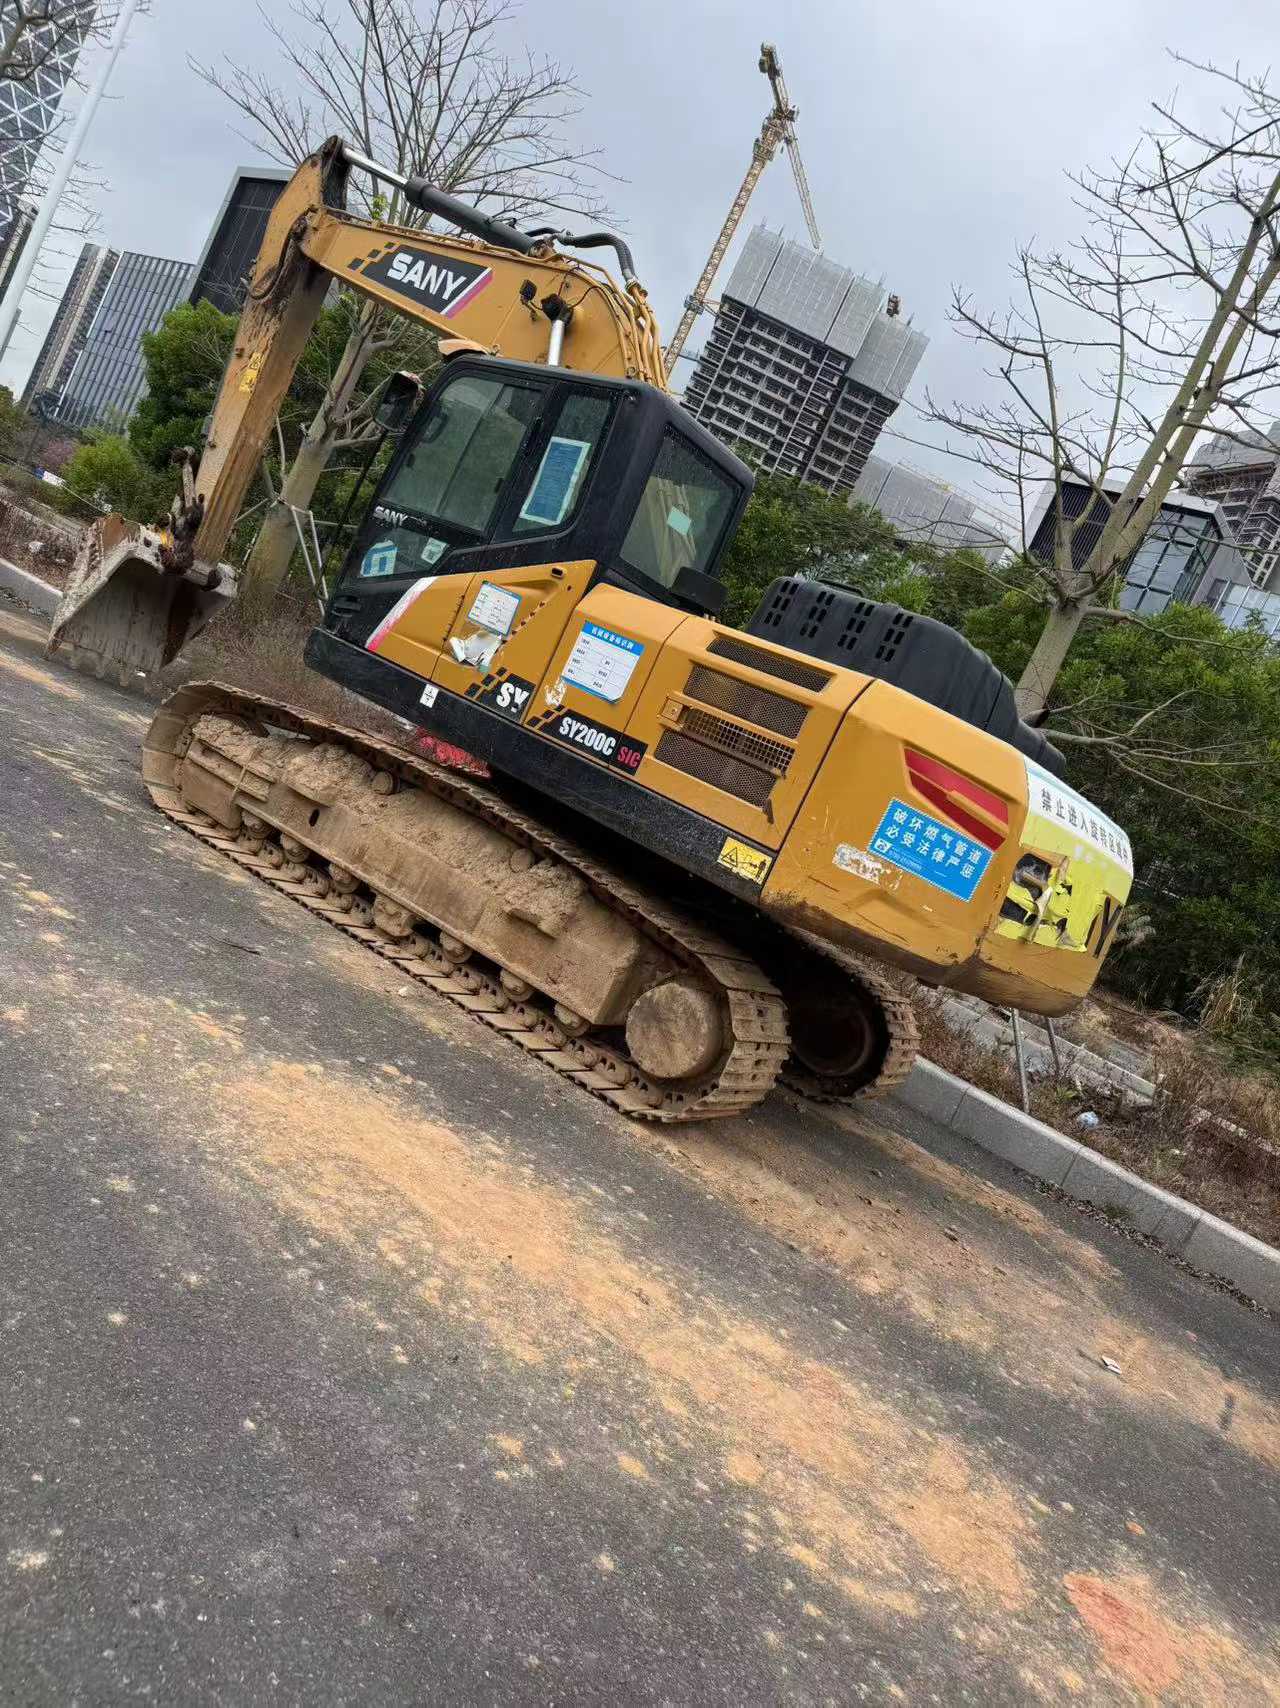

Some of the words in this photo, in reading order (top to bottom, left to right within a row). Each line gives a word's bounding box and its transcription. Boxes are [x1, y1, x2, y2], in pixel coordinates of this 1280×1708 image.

[387, 252, 467, 300] SANY
[373, 505, 408, 527] SANY
[559, 716, 617, 757] SY200C
[886, 826, 976, 878] 必受法律严惩
[893, 808, 981, 865] 破坏燃气管道
